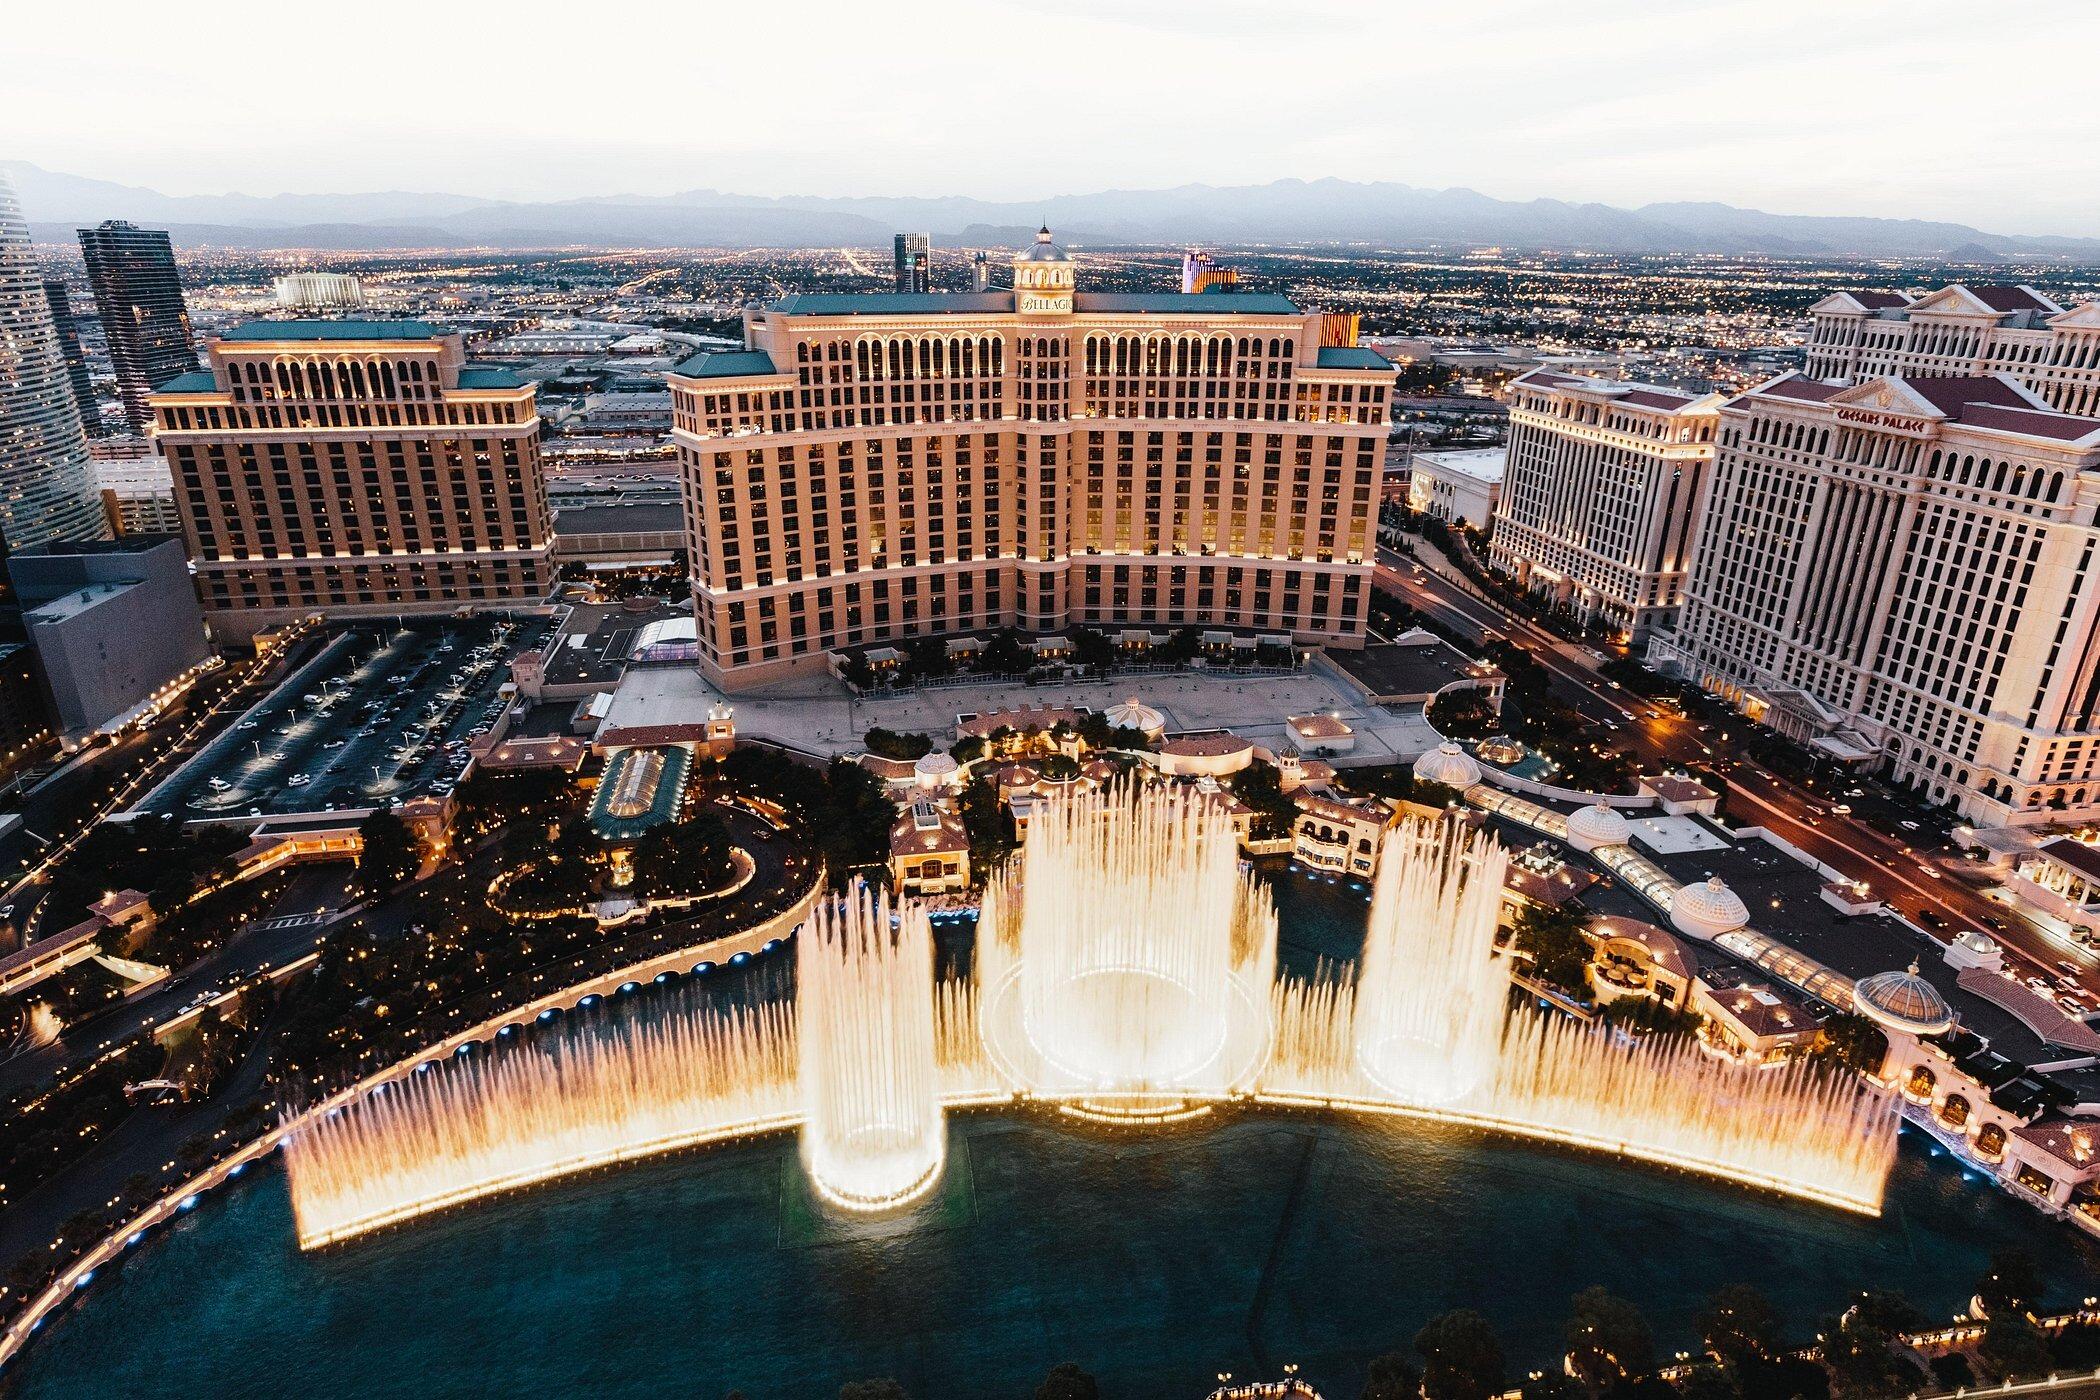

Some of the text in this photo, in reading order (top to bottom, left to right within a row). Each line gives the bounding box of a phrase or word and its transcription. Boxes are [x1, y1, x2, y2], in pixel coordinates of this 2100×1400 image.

[1021, 297, 1073, 310] BELLAGIO
[1837, 409, 1925, 432] CAESARS PALACE
